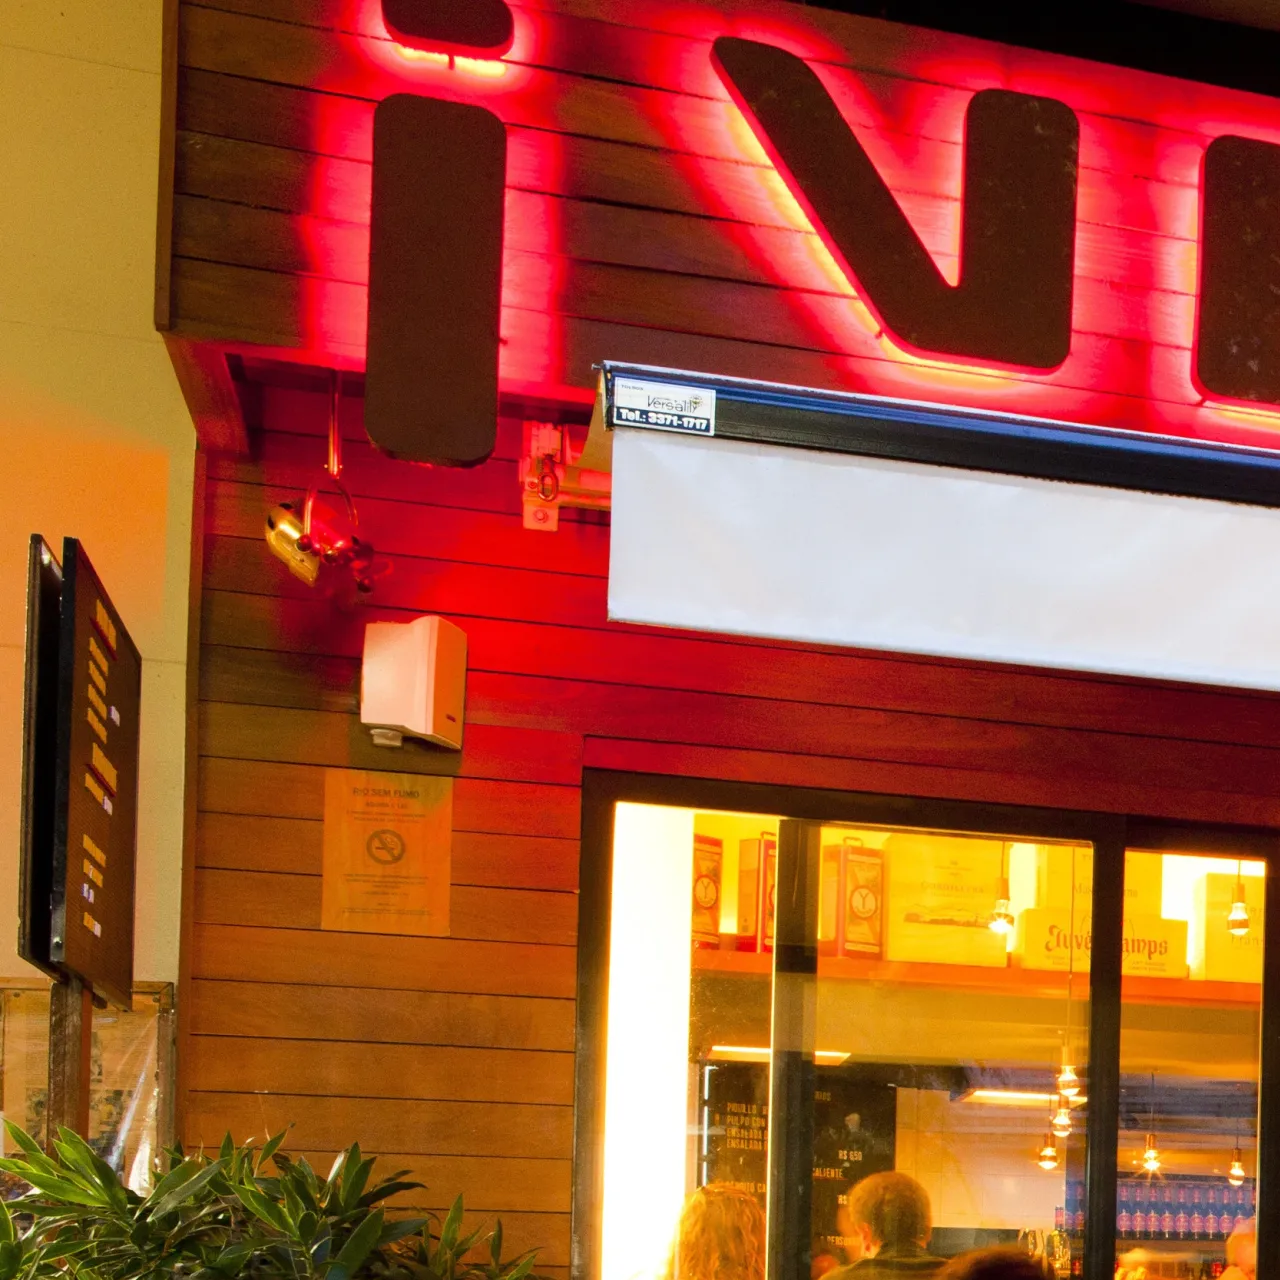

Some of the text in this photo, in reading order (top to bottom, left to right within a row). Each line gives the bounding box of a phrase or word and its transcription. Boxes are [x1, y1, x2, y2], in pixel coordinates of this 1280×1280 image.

[619, 408, 708, 430] Tel.: 3371-1717
[371, 788, 391, 797] SEM
[393, 789, 420, 798] FUMO
[1122, 936, 1168, 958] amps
